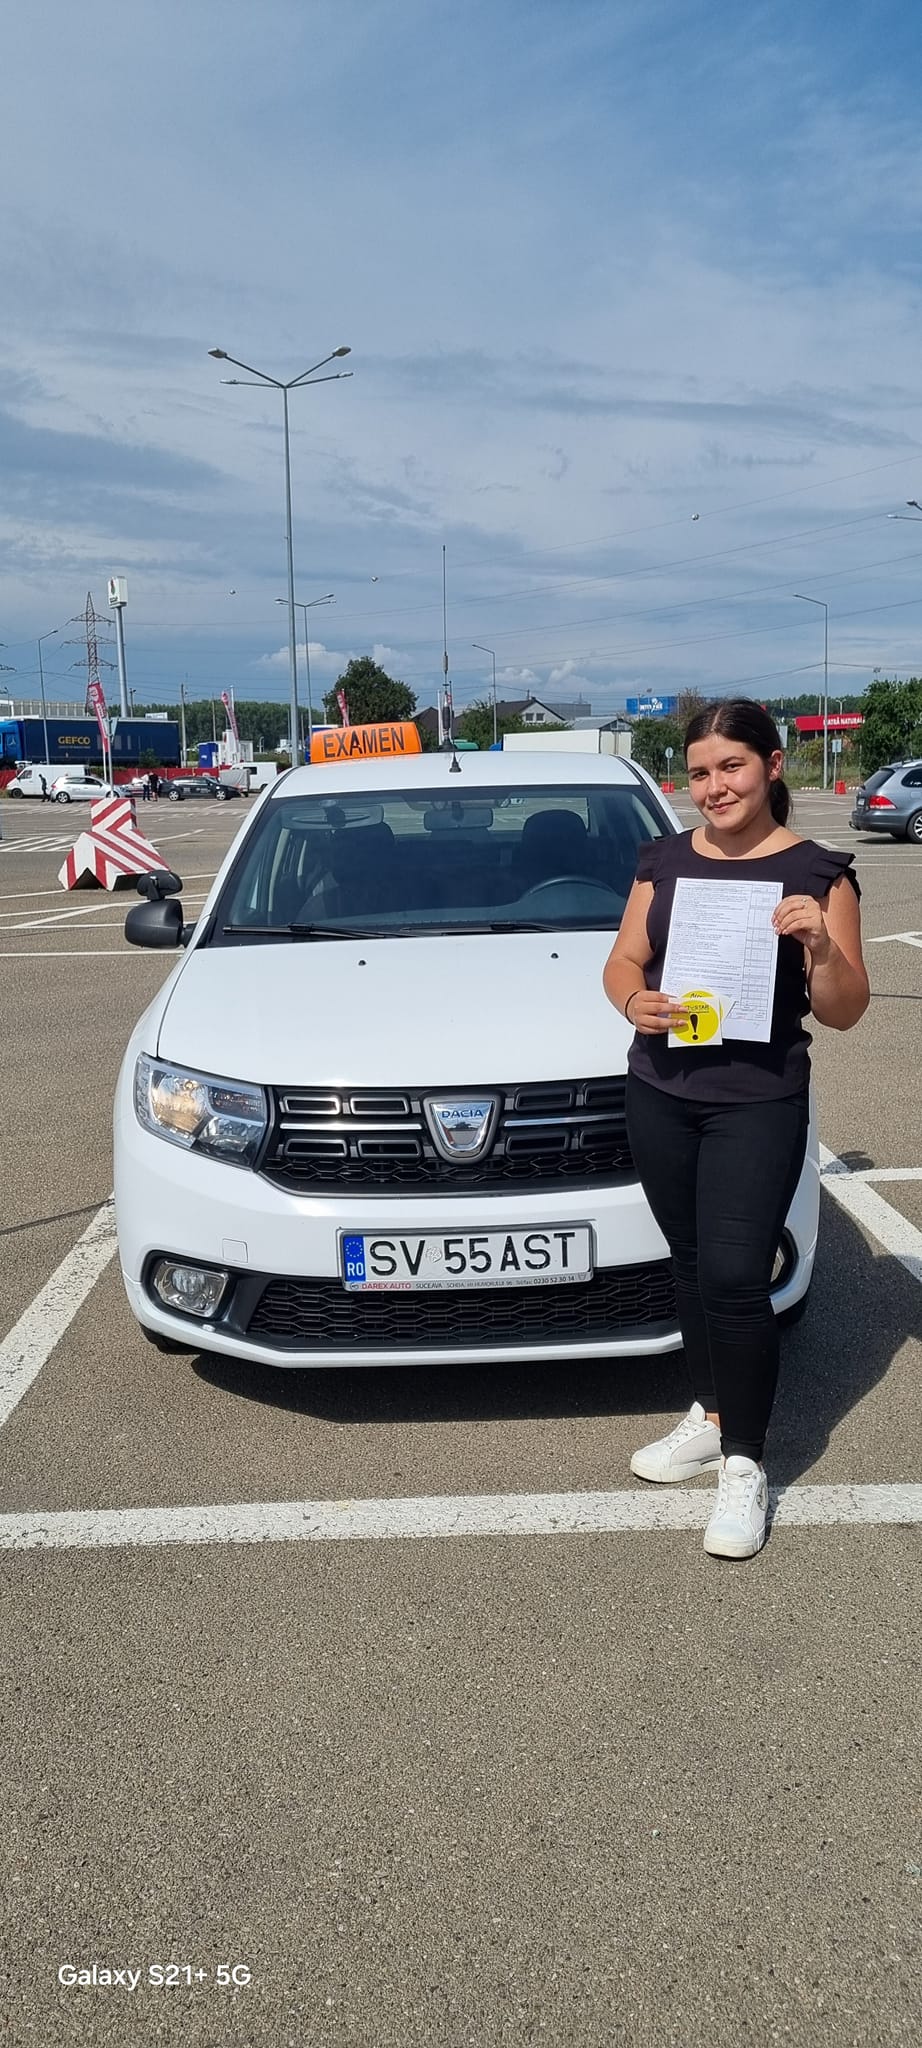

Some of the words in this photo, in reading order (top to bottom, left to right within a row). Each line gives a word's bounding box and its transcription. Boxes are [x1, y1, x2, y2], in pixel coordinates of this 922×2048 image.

[841, 716, 865, 725] NATURAL
[58, 736, 91, 745] GEFCO
[323, 726, 405, 759] EXAMEN
[441, 1109, 484, 1119] DACIA
[369, 1239, 426, 1277] SV
[443, 1237, 492, 1275] 55
[500, 1232, 576, 1272] AST
[347, 1262, 364, 1277] RO
[533, 1277, 550, 1285] 0230
